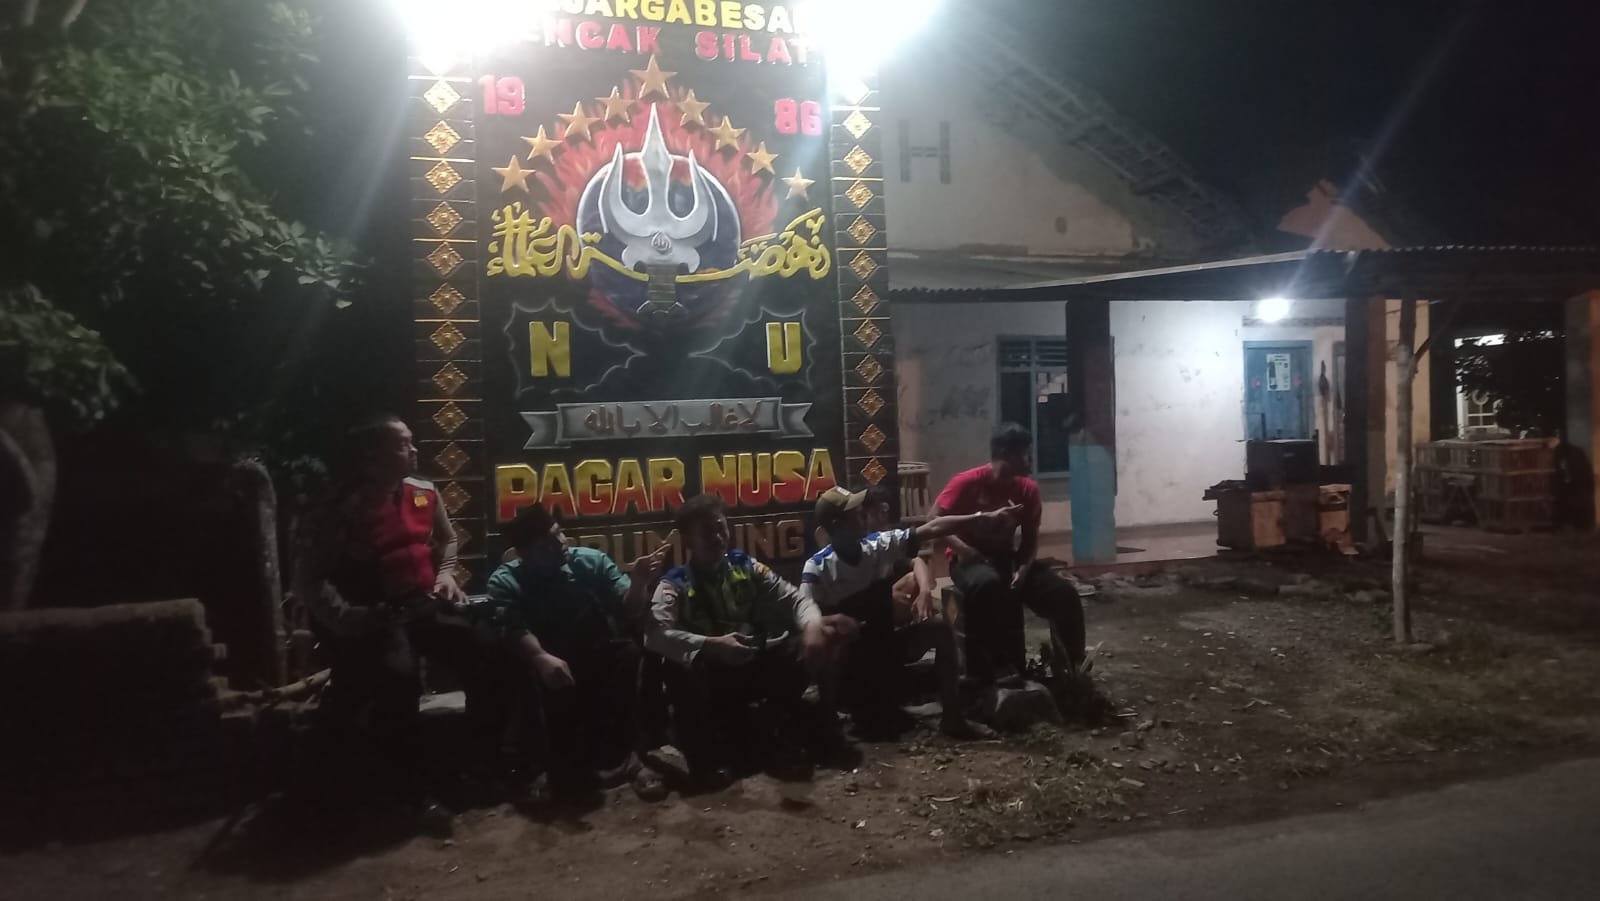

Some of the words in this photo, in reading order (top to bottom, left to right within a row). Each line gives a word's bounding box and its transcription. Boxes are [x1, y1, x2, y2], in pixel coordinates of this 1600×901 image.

[695, 31, 811, 66] SILAT
[478, 75, 525, 115] 19
[774, 98, 823, 137] 86
[529, 321, 571, 377] N
[766, 321, 802, 374] U
[495, 456, 686, 523] PAGAR
[700, 448, 838, 507] NUSA
